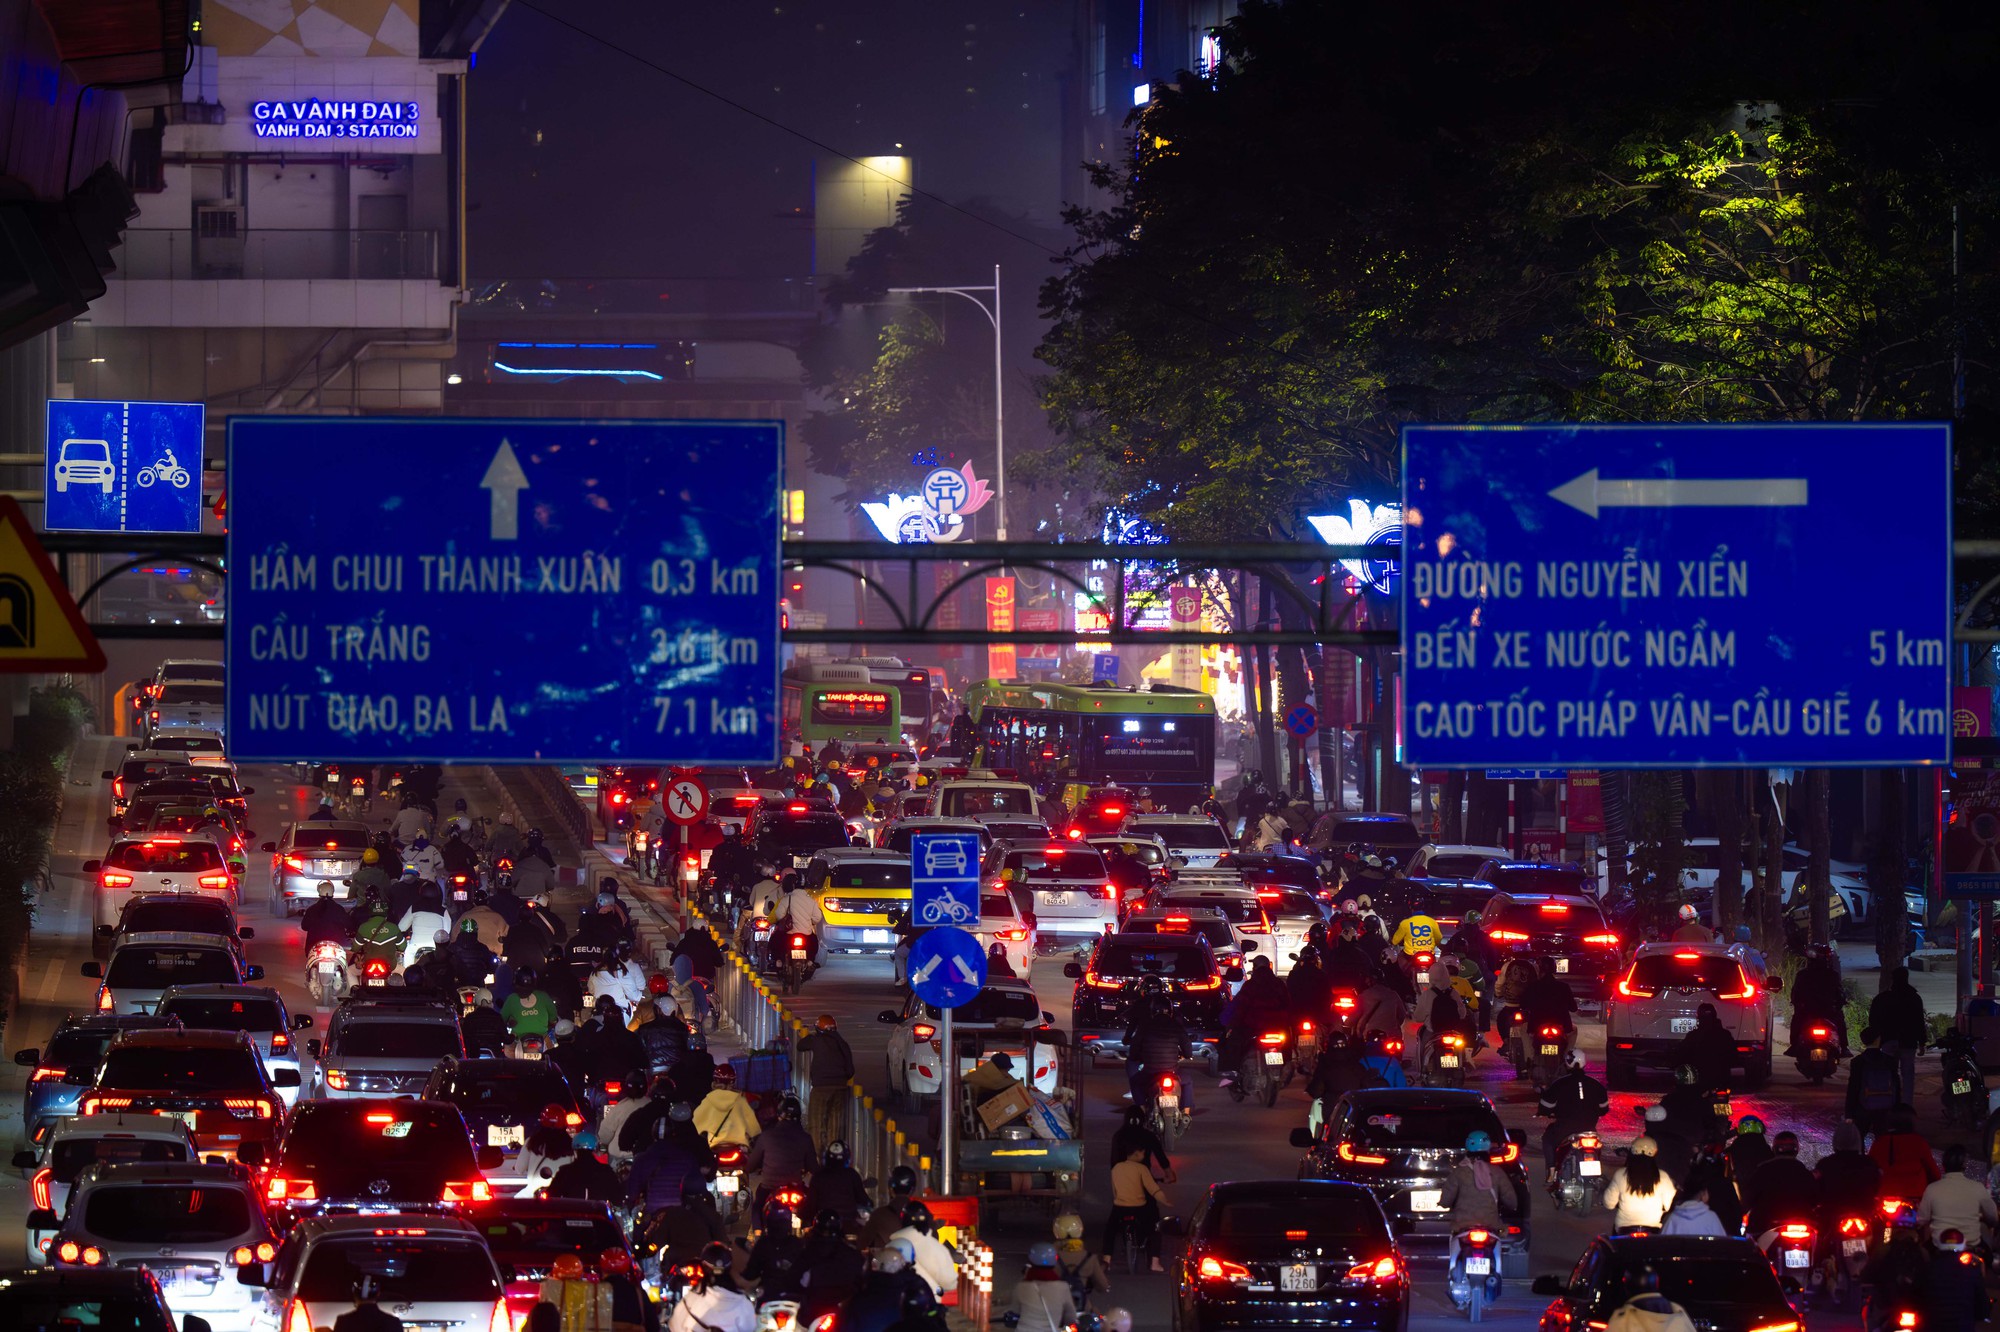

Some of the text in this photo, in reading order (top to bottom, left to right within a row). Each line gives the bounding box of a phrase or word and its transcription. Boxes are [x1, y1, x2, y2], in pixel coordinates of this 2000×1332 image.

[254, 97, 419, 119] GA VÀNH ĐAI 3
[255, 124, 417, 137] VANH DAI 3 STATION
[250, 541, 759, 597] HẦM CHUI THANH XUÂN 0,3 km
[1411, 544, 1748, 599] ĐƯỜNG NGUYỄN XIỂN
[250, 610, 308, 661] CẦU
[325, 608, 431, 662] TRẮNG
[710, 628, 759, 665] km
[1414, 617, 1944, 668] BẾN XE NƯỚC NGẦM 5 km
[250, 683, 759, 735] NÚT GIAO BA LA 7,1 km
[1415, 700, 1474, 738] CAO
[1486, 686, 1546, 738] TỐC
[1557, 689, 1636, 738] PHÁP
[1803, 691, 1851, 737] GIẼ
[1866, 699, 1882, 736] 6
[1898, 699, 1945, 736] km
[1409, 922, 1432, 938] be
[1411, 938, 1432, 947] Food
[521, 1008, 539, 1017] Grab
[499, 1127, 514, 1136] 15A
[158, 1269, 177, 1281] 29A
[1289, 1262, 1308, 1278] 29A
